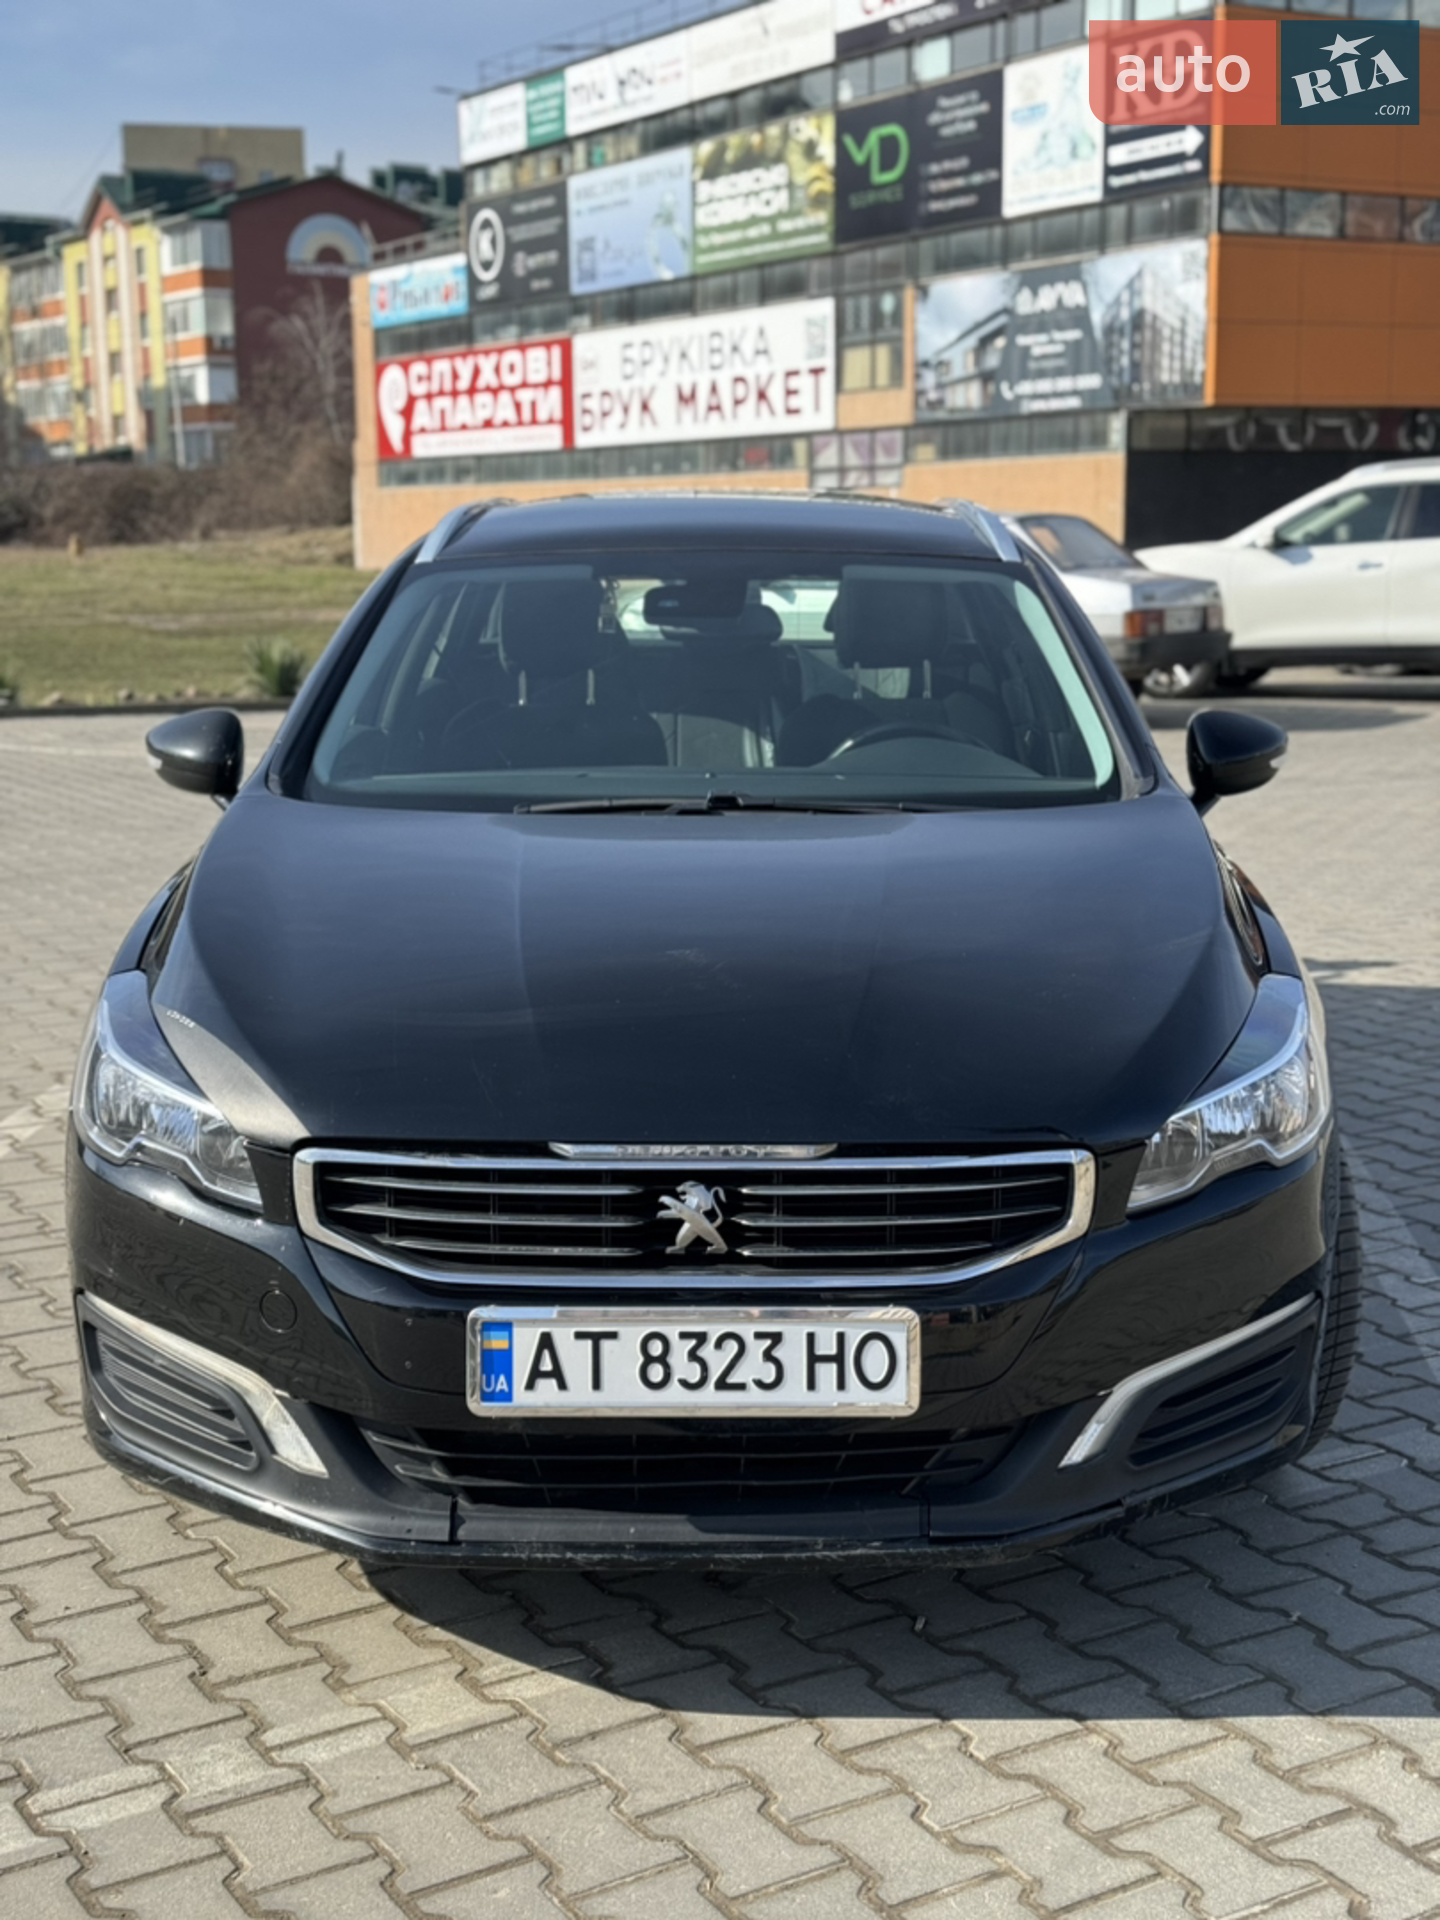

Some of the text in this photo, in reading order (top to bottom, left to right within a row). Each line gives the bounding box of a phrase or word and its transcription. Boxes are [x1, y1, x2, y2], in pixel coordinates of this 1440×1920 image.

[408, 343, 562, 396] СЛУХОВІ
[621, 325, 772, 381] БРУКІВКА
[411, 384, 563, 433] АПАРАТИ
[580, 367, 827, 432] БРУК МАРКЕТ
[482, 1374, 509, 1393] UA
[524, 1331, 898, 1392] AT 8323 HO
